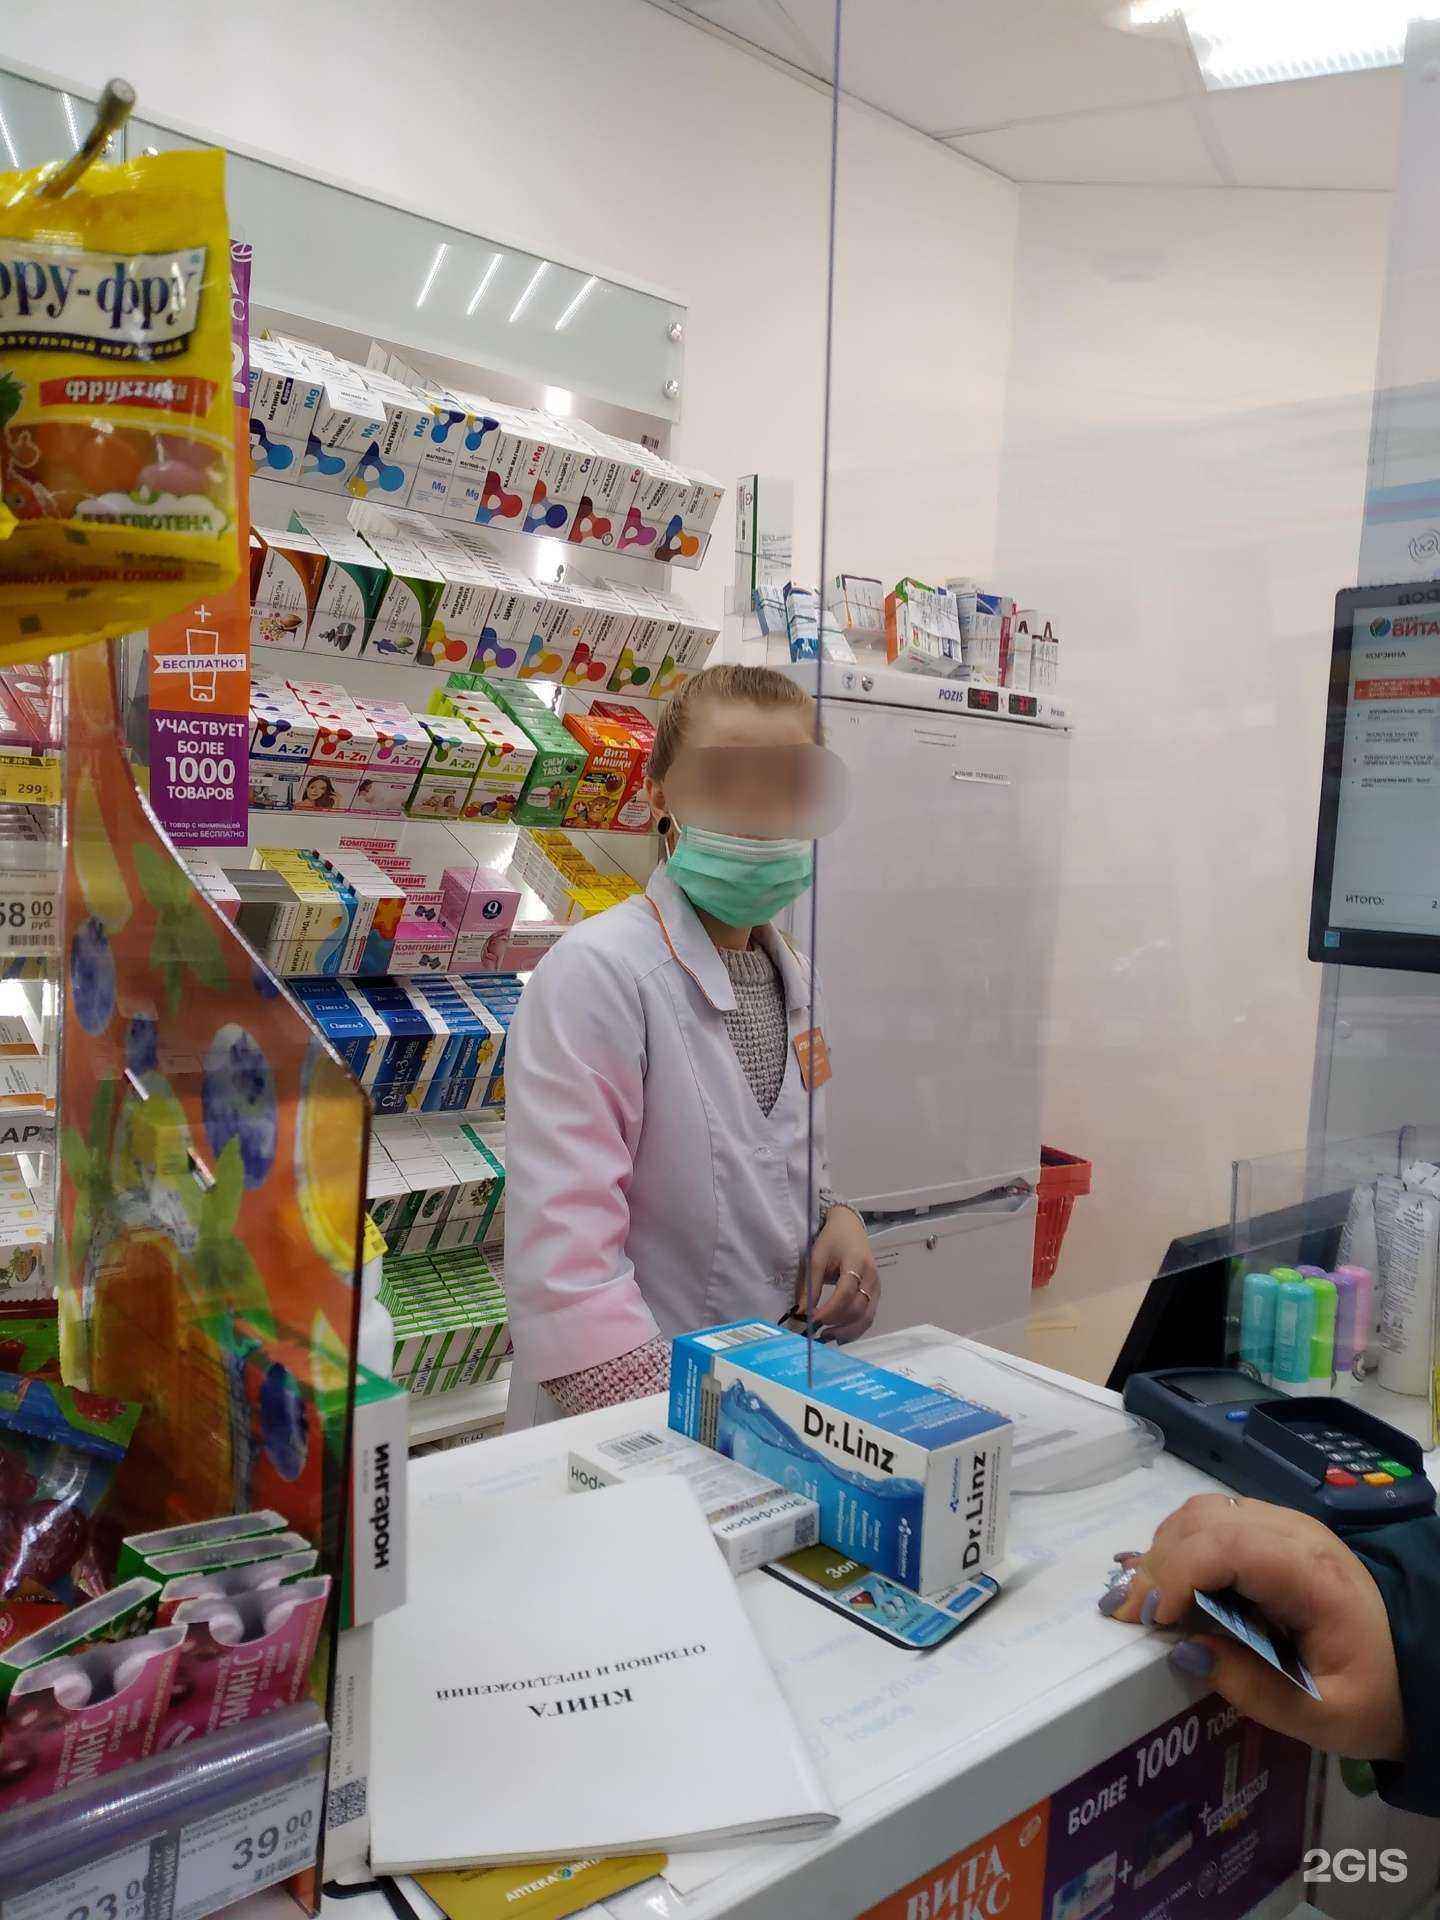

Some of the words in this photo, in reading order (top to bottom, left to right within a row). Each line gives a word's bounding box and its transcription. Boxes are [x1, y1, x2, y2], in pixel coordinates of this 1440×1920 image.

[304, 388, 320, 409] Mg
[361, 421, 381, 438] Mg
[414, 416, 430, 437] Mg
[580, 458, 591, 473] Ca
[630, 469, 641, 483] Fe
[432, 480, 447, 493] Mg
[465, 488, 480, 500] Mg
[502, 597, 516, 621] ЦИНК
[162, 659, 244, 671] БЕСПЛАТНО!
[938, 688, 964, 702] POZIS
[155, 717, 245, 738] УЧАСТВУЕТ
[177, 740, 225, 755] БОЛЕЕ
[278, 743, 308, 755] A-Zn
[335, 750, 367, 762] A-Zn
[391, 755, 421, 767] A-Zn
[450, 758, 476, 769] A-Zn
[165, 756, 236, 785] 1000
[502, 763, 527, 774] A-Zn
[17, 784, 43, 795] 299
[166, 785, 235, 801] ТОВАРОВ
[200, 829, 245, 839] БЕСПЛАТНО
[339, 839, 397, 849] КОМПЛИВИТ
[31, 902, 53, 917] 00
[395, 943, 453, 952] КОМПЛИВИТ
[802, 1403, 895, 1475] Dr.Linz
[962, 1451, 986, 1570] Dr.Linz
[615, 1643, 707, 1673] ОТЗЫВОВ
[597, 1665, 611, 1677] И
[433, 1669, 592, 1701] ПРЕДЛОЖЕНИЙ
[527, 1687, 635, 1719] КНИГА
[1067, 1775, 1129, 1838] БОЛЕЕ
[1136, 1714, 1199, 1788] 1000
[231, 1827, 280, 1871] 39
[286, 1809, 313, 1834] 00
[505, 1874, 560, 1902] АПТЕКА
[906, 1844, 1006, 1920] ВИТА
